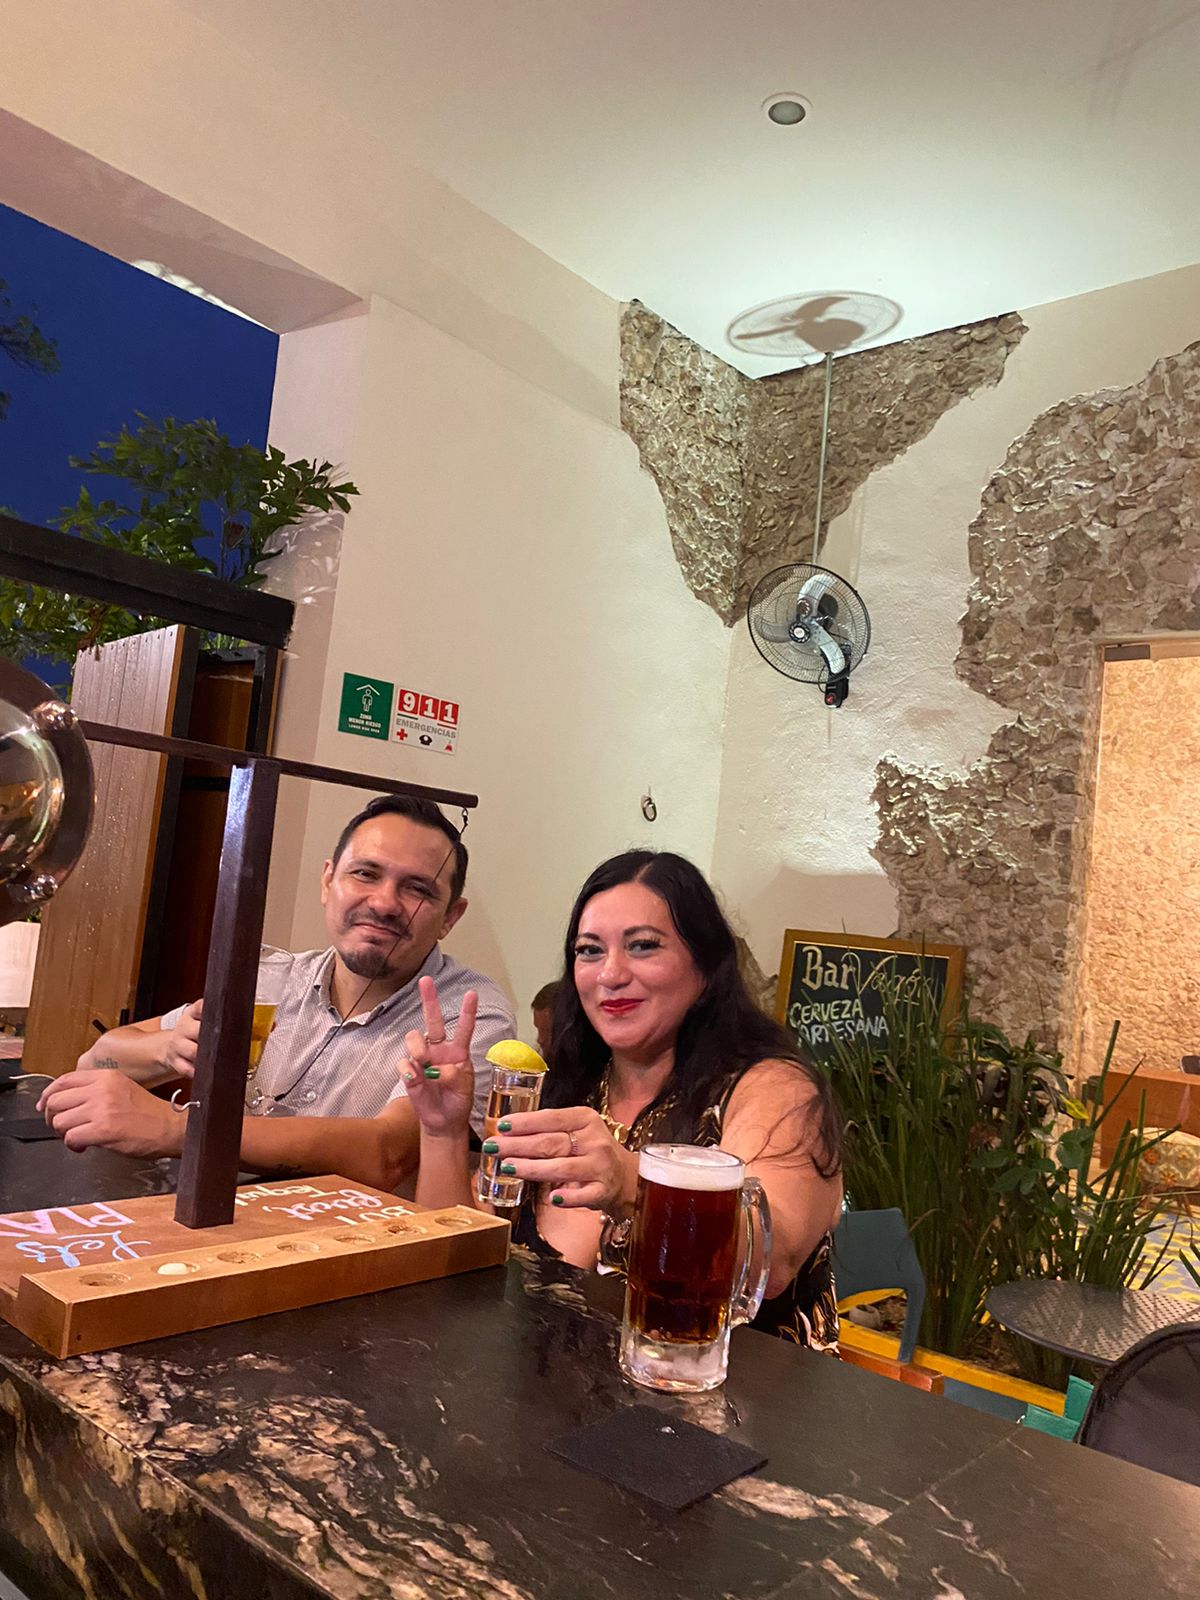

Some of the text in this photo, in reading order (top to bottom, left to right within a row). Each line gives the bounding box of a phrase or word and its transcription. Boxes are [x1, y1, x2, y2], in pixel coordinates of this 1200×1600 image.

[360, 713, 372, 721] ZONA
[402, 692, 456, 723] 911
[396, 718, 457, 739] EMERGENCIAS
[802, 945, 855, 991] Bar
[789, 998, 864, 1027] CERVEZA
[797, 1014, 904, 1047] ARTESANA
[234, 1185, 338, 1207] Tequil
